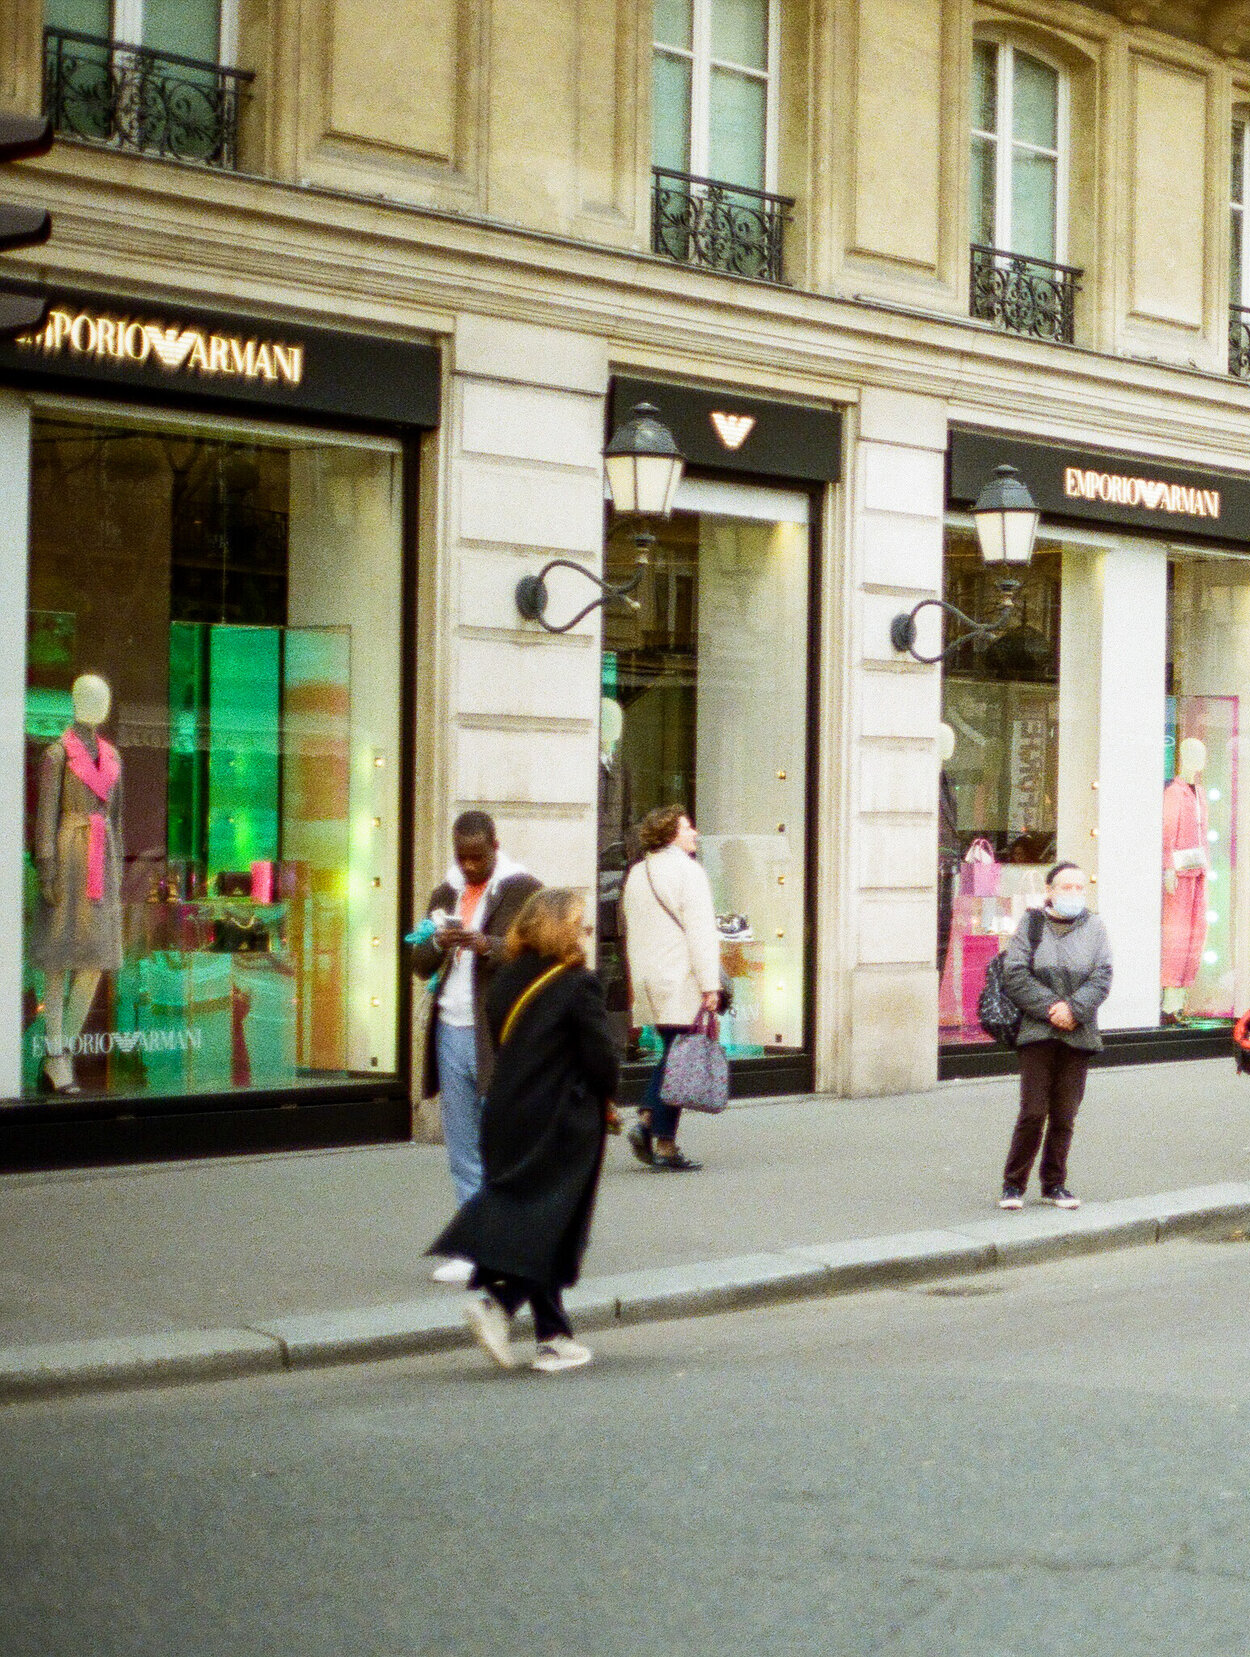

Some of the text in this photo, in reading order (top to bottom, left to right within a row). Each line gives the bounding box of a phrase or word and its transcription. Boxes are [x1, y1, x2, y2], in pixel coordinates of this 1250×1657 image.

[188, 333, 303, 382] ARMANI
[1065, 467, 1220, 518] EMPORIO ARMANI
[138, 1028, 202, 1052] ARMANI
